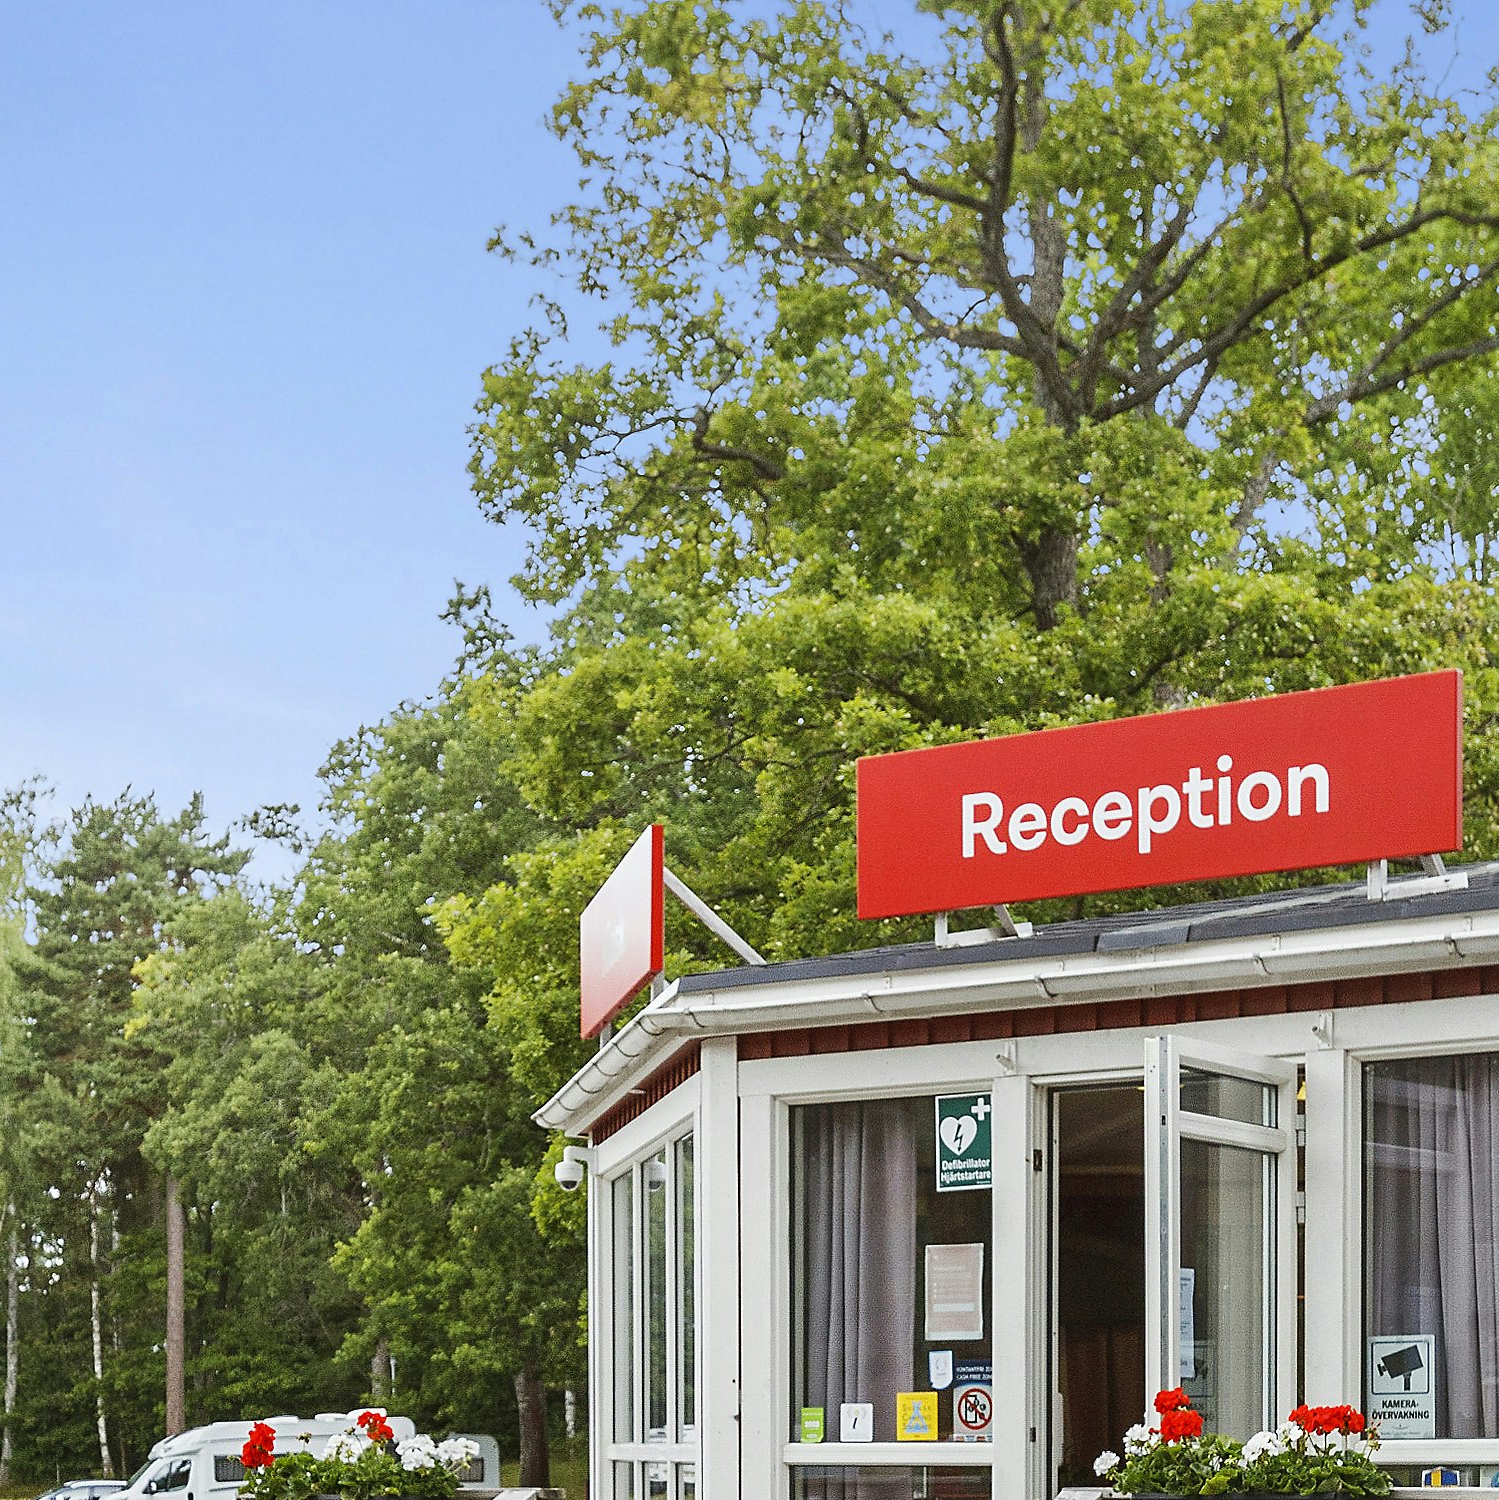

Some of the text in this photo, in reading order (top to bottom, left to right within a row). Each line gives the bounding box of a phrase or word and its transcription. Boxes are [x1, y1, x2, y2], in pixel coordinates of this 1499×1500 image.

[960, 753, 1332, 859] Reception
[941, 1158, 991, 1171] Defibrillator
[940, 1170, 992, 1184] Hjärtstartare
[1381, 1399, 1420, 1409] KAMERA-
[1371, 1408, 1430, 1420] ÖVERVAKNING
